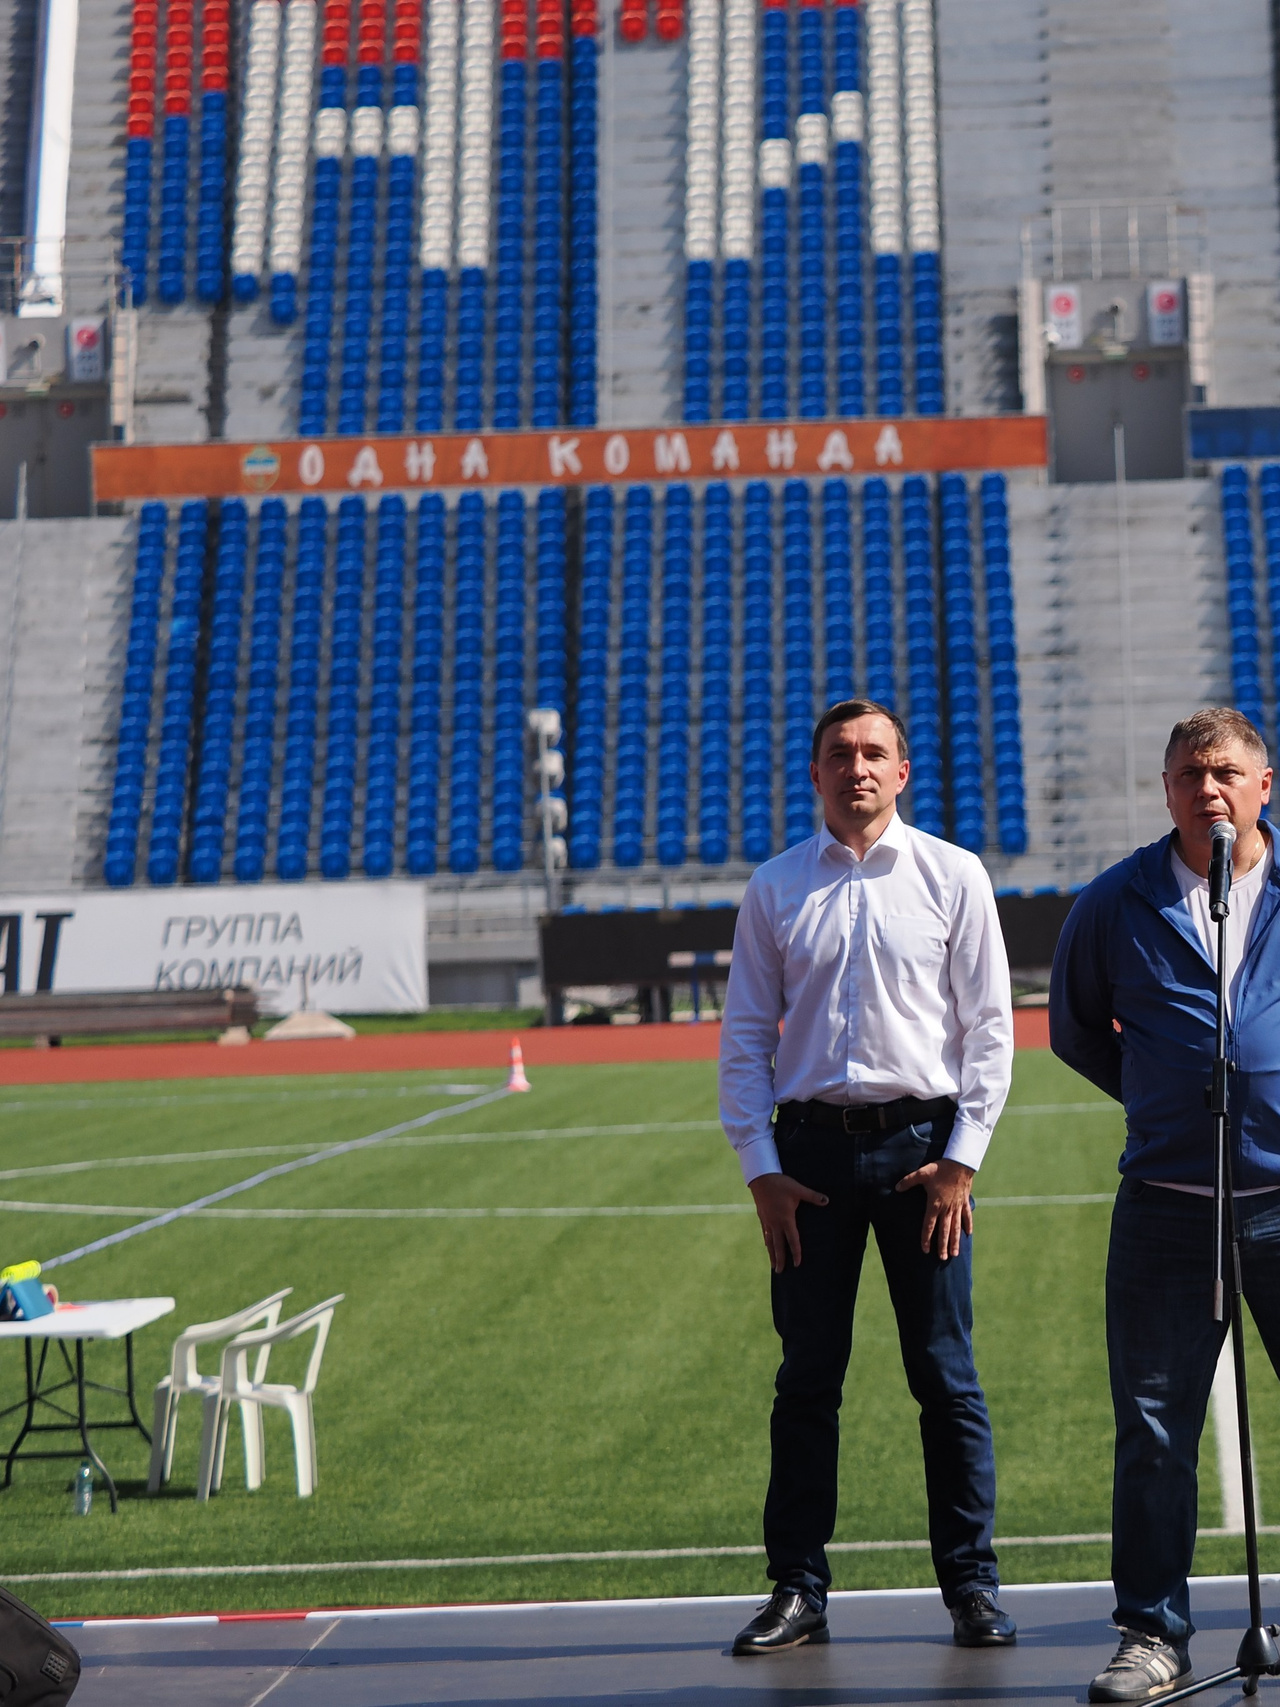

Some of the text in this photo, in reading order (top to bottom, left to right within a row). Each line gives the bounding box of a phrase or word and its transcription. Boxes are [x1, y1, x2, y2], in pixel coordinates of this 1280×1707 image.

[300, 424, 904, 489] ОДНА КОМАНДА
[161, 911, 304, 949] ГРУППА
[154, 946, 364, 991] КОМПАНИЙ
